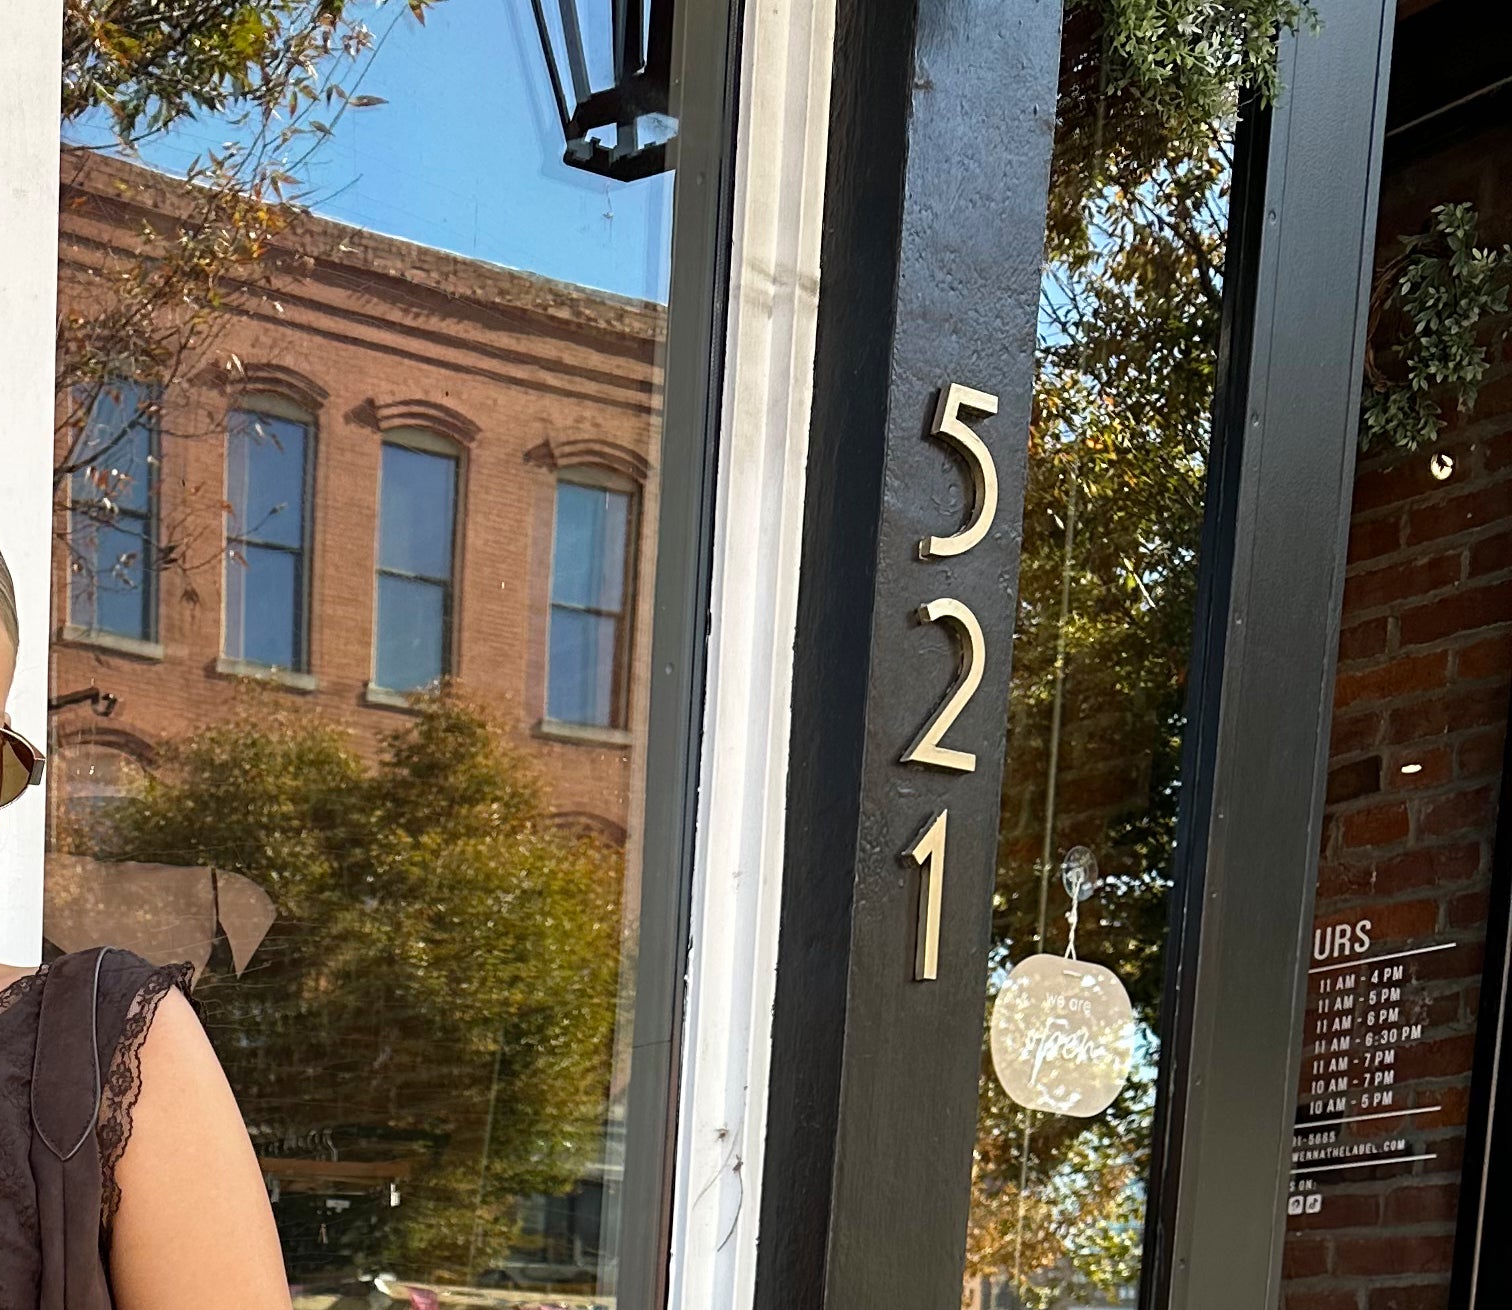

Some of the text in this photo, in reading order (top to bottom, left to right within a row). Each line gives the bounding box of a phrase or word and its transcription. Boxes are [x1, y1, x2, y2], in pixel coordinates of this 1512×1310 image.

[902, 382, 999, 981] 521
[1320, 979, 1330, 993] 11
[1336, 973, 1355, 990] AM
[1371, 970, 1378, 983] 4
[1384, 965, 1403, 982] PM
[1046, 991, 1092, 1014] we are
[1319, 999, 1329, 1013] 11
[1334, 994, 1353, 1010] AM
[1369, 991, 1376, 1004] 5
[1381, 987, 1400, 1002] PM
[1317, 1020, 1327, 1033] 11
[1332, 1014, 1351, 1031] AM
[1379, 1007, 1398, 1023] PM
[1315, 1040, 1325, 1054] 11
[1331, 1035, 1350, 1051] AM
[1366, 1029, 1397, 1046] 6:30
[1402, 1024, 1421, 1040] PM
[1313, 1060, 1323, 1074] 11
[1329, 1056, 1348, 1071] AM
[1365, 1053, 1370, 1067] 7
[1375, 1049, 1394, 1065] PM
[1312, 1080, 1324, 1094] 10
[1329, 1076, 1347, 1092] AM
[1365, 1074, 1370, 1087] 7
[1375, 1069, 1394, 1086] PM
[1310, 1101, 1322, 1114] 10
[1327, 1096, 1346, 1112] AM
[1362, 1094, 1368, 1108] 5
[1373, 1090, 1392, 1106] PM
